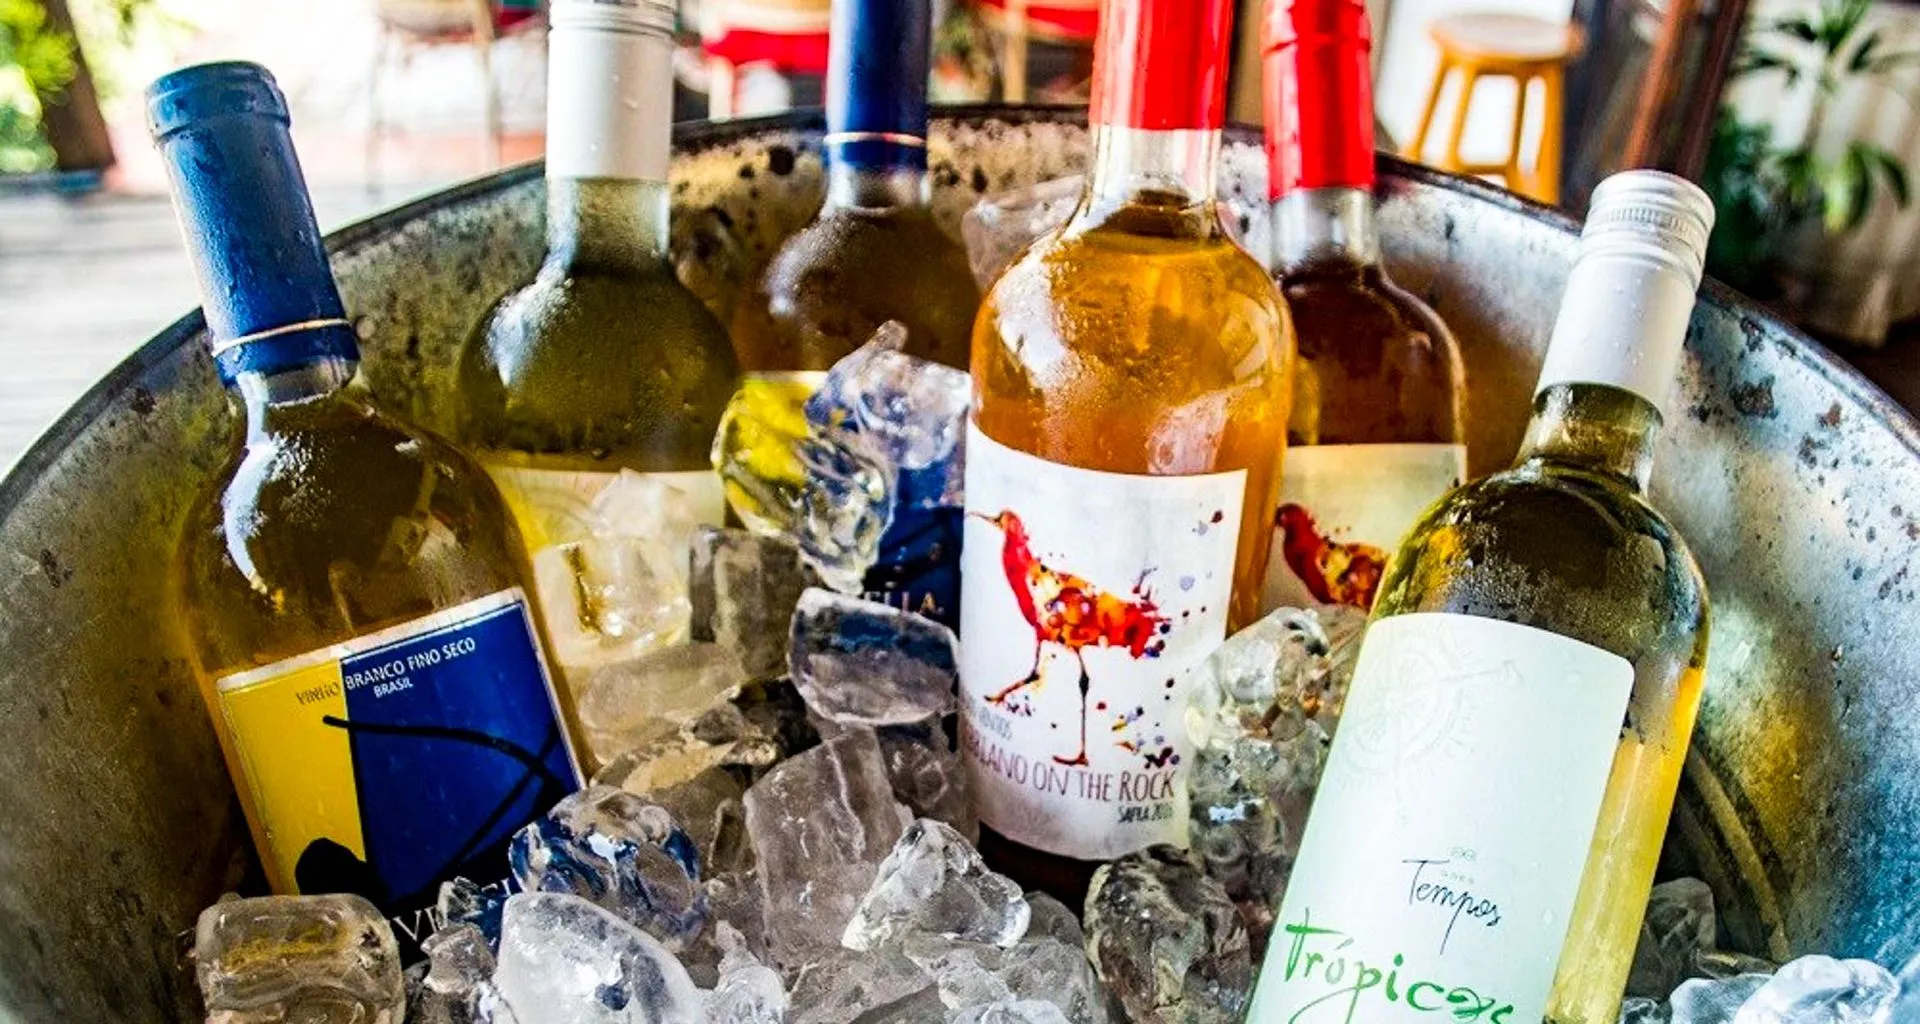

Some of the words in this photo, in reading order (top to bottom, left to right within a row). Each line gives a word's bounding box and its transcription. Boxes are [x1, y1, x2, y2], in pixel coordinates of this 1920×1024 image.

[345, 660, 406, 690] BRANCO
[407, 649, 441, 671] FINO
[444, 637, 476, 660] SECO
[373, 676, 414, 698] BRASIL
[1033, 762, 1069, 796] ON
[1072, 770, 1113, 802] THE
[1118, 770, 1176, 801] ROCK
[1401, 859, 1502, 956] Tempos
